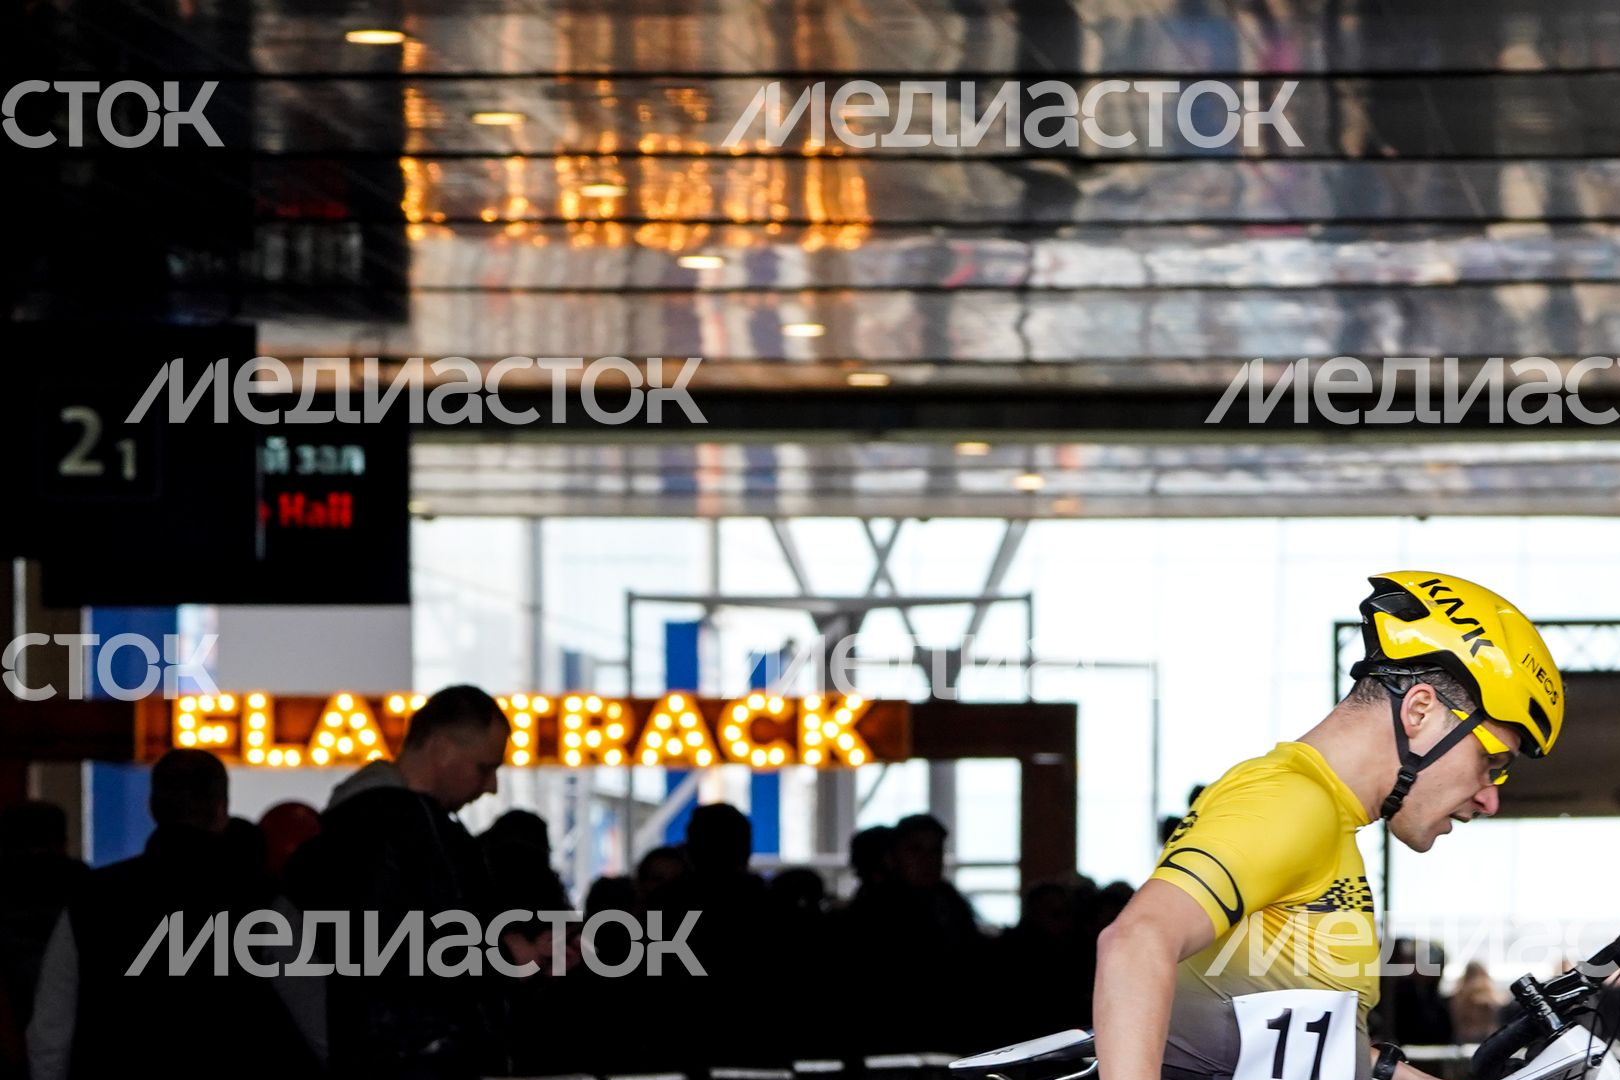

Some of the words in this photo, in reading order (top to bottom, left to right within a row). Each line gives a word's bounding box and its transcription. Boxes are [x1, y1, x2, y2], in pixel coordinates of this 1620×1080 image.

[278, 493, 353, 528] Hall
[1417, 578, 1495, 658] KASK
[1520, 653, 1560, 706] INEOS
[496, 691, 875, 767] TRACK
